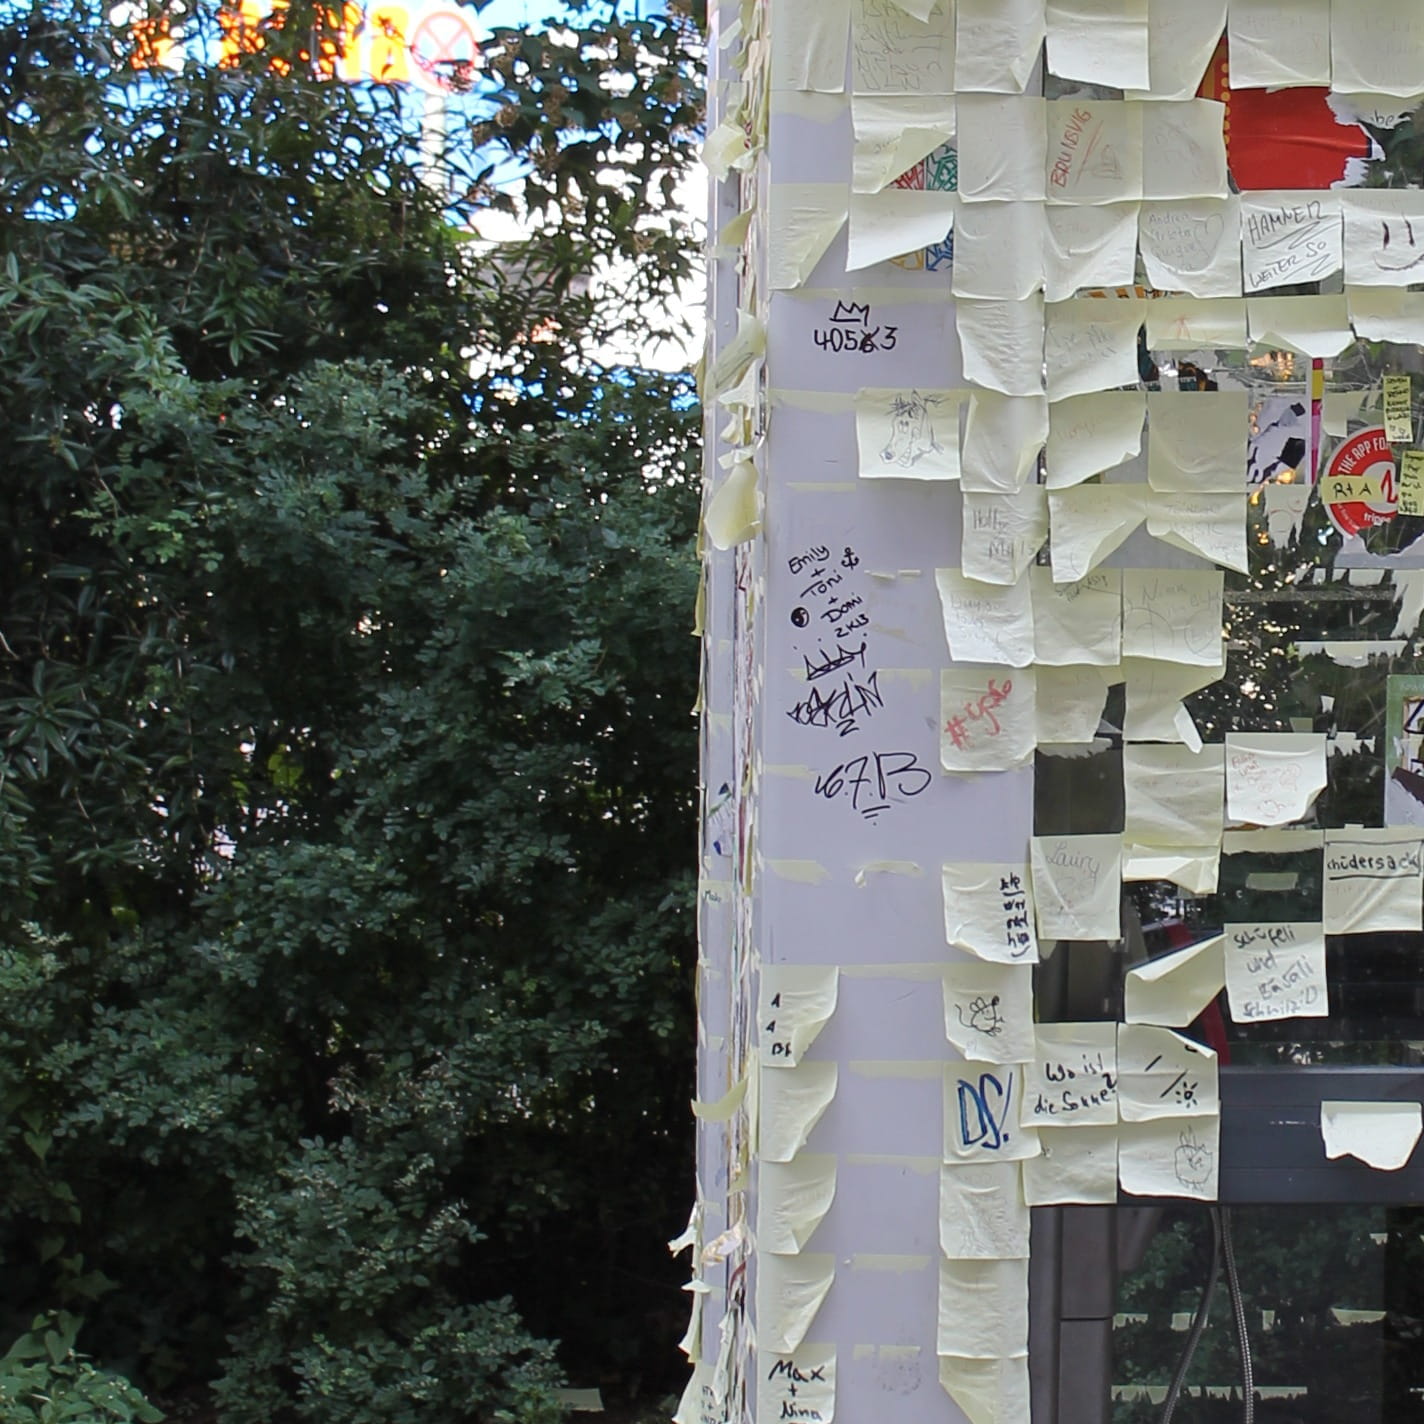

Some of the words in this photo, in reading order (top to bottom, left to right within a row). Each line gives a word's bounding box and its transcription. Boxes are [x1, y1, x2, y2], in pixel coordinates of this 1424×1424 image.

[1338, 454, 1357, 474] THE
[788, 544, 831, 575] Emily
[800, 568, 843, 598] Toni
[767, 1358, 826, 1384] Max
[779, 1399, 823, 1422] Nina
